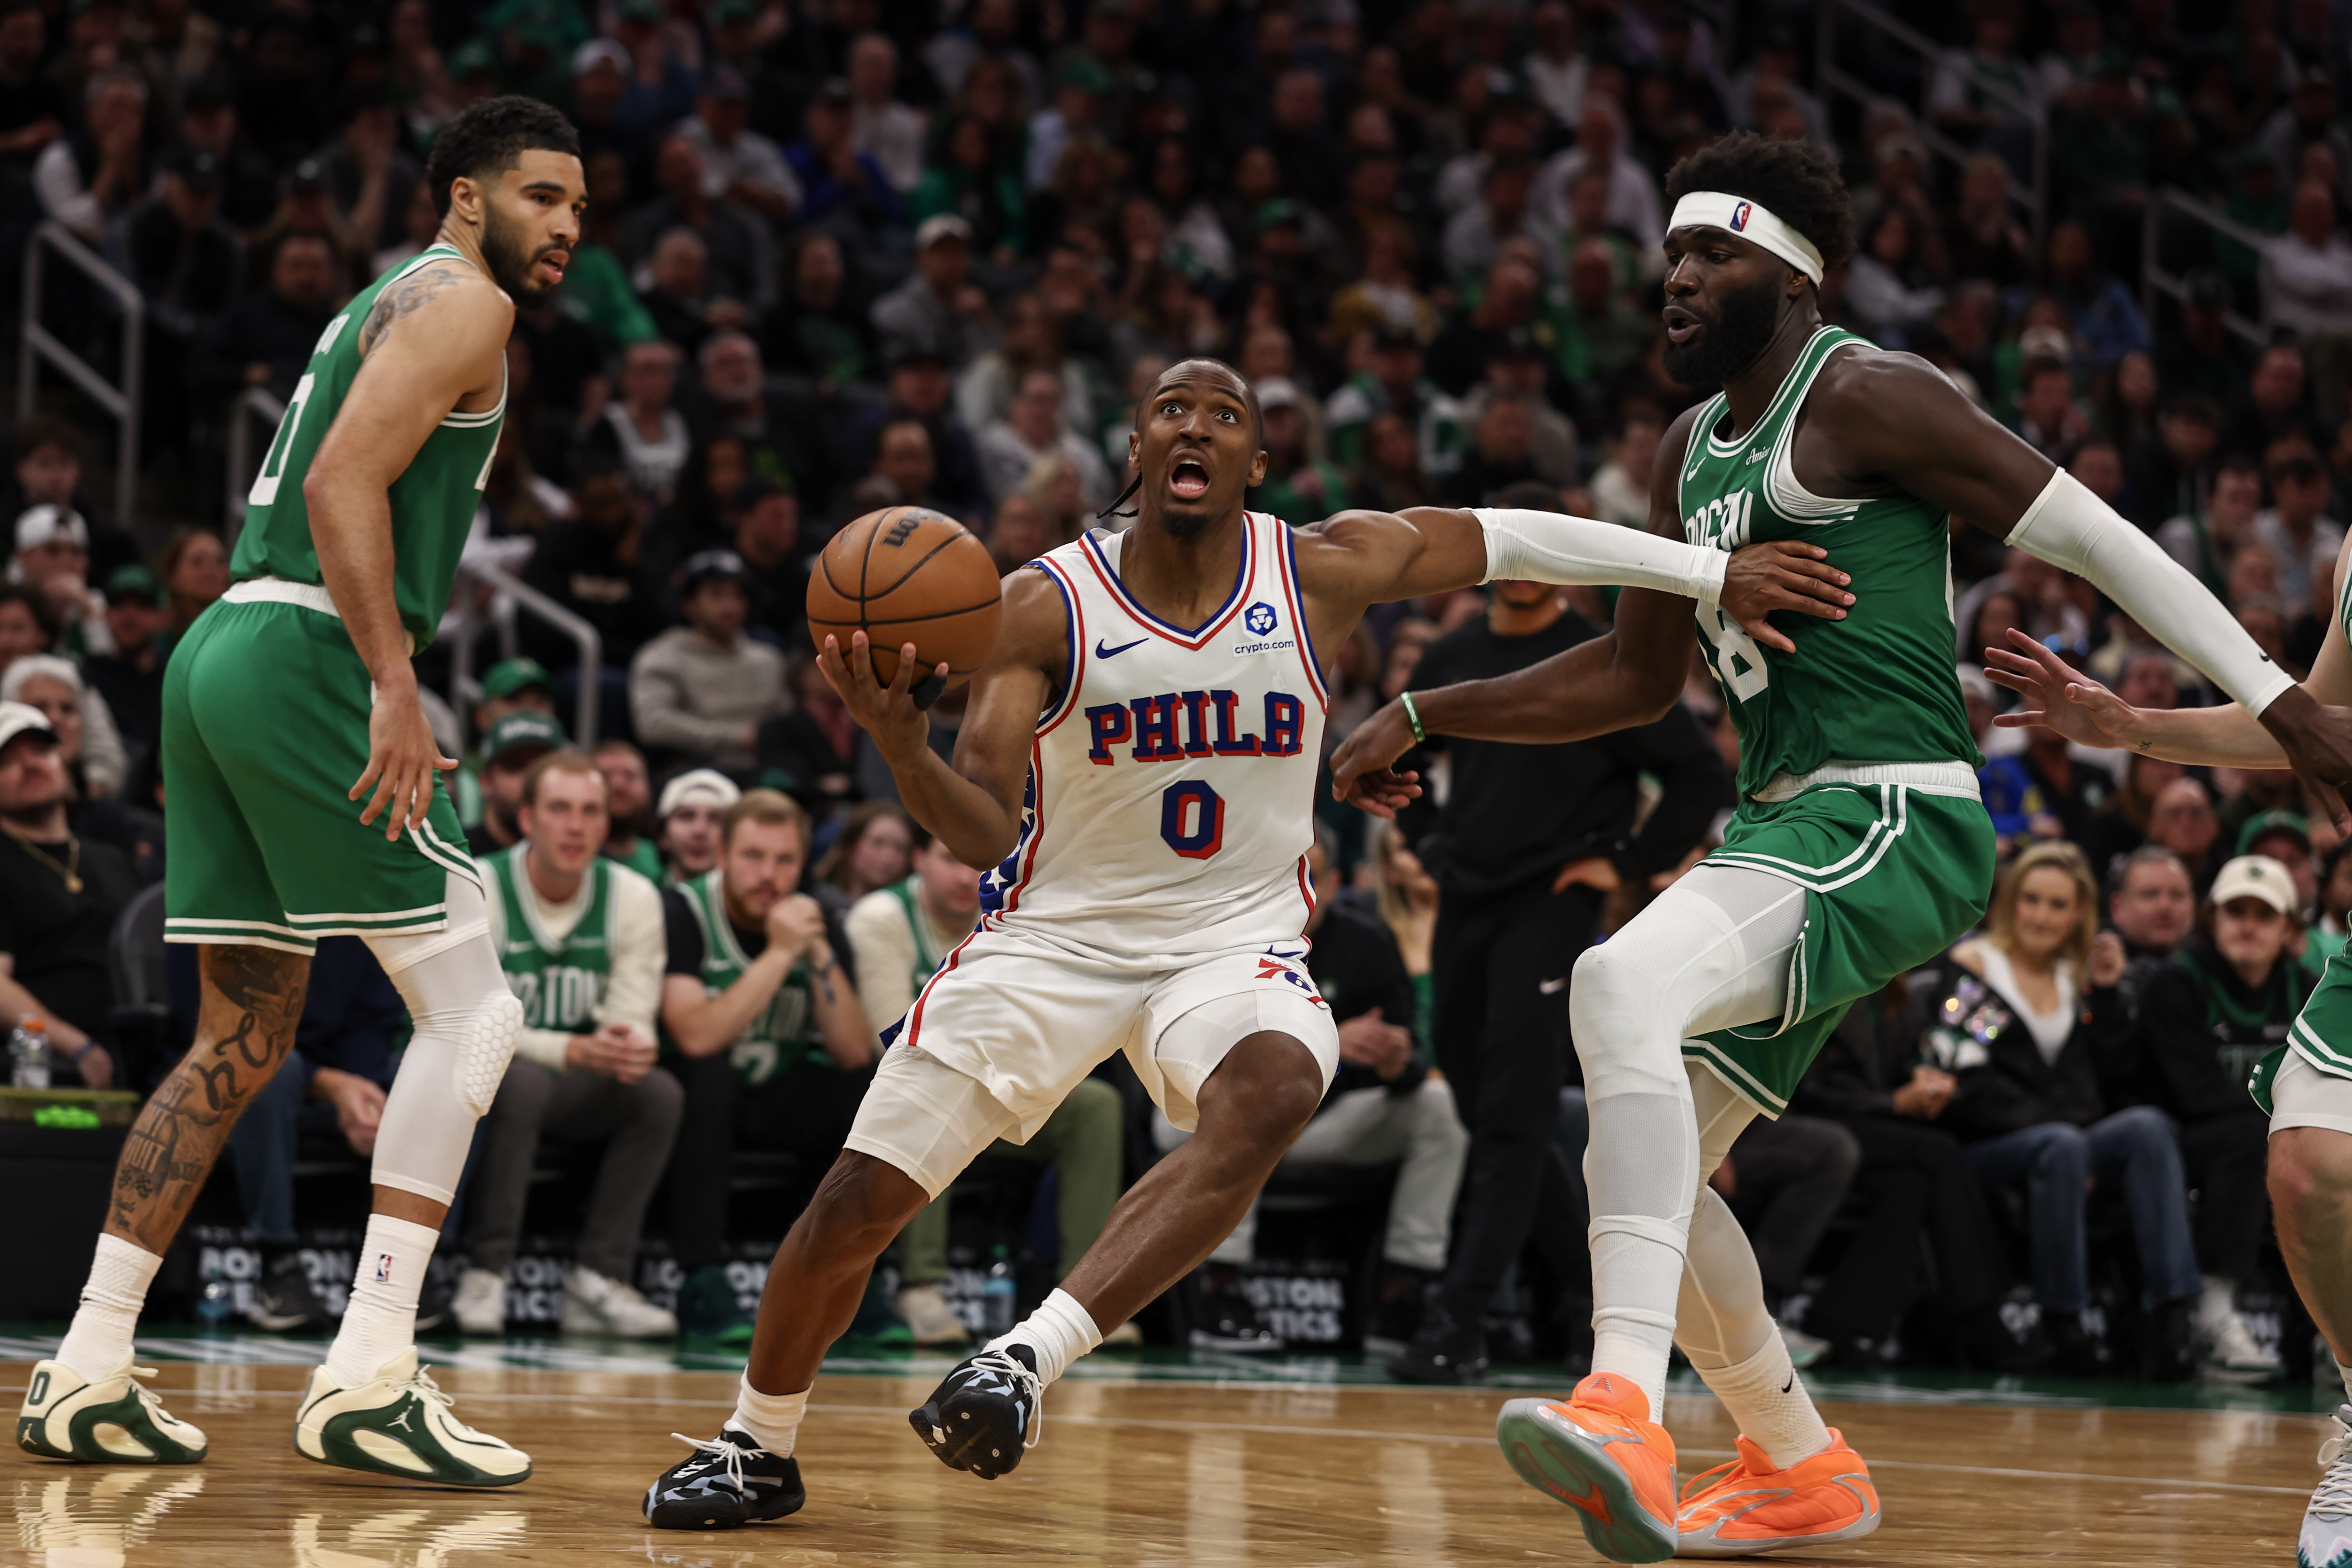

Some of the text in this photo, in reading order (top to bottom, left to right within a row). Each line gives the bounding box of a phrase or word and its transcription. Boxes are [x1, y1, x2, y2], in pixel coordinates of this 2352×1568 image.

[1746, 446, 1771, 465] Amica
[1235, 641, 1294, 654] crypto.com
[1695, 597, 1768, 704] 8
[1084, 689, 1305, 766] PHILA
[1160, 779, 1225, 860] 0
[1242, 1277, 1343, 1307] STON
[28, 1371, 51, 1405] 0
